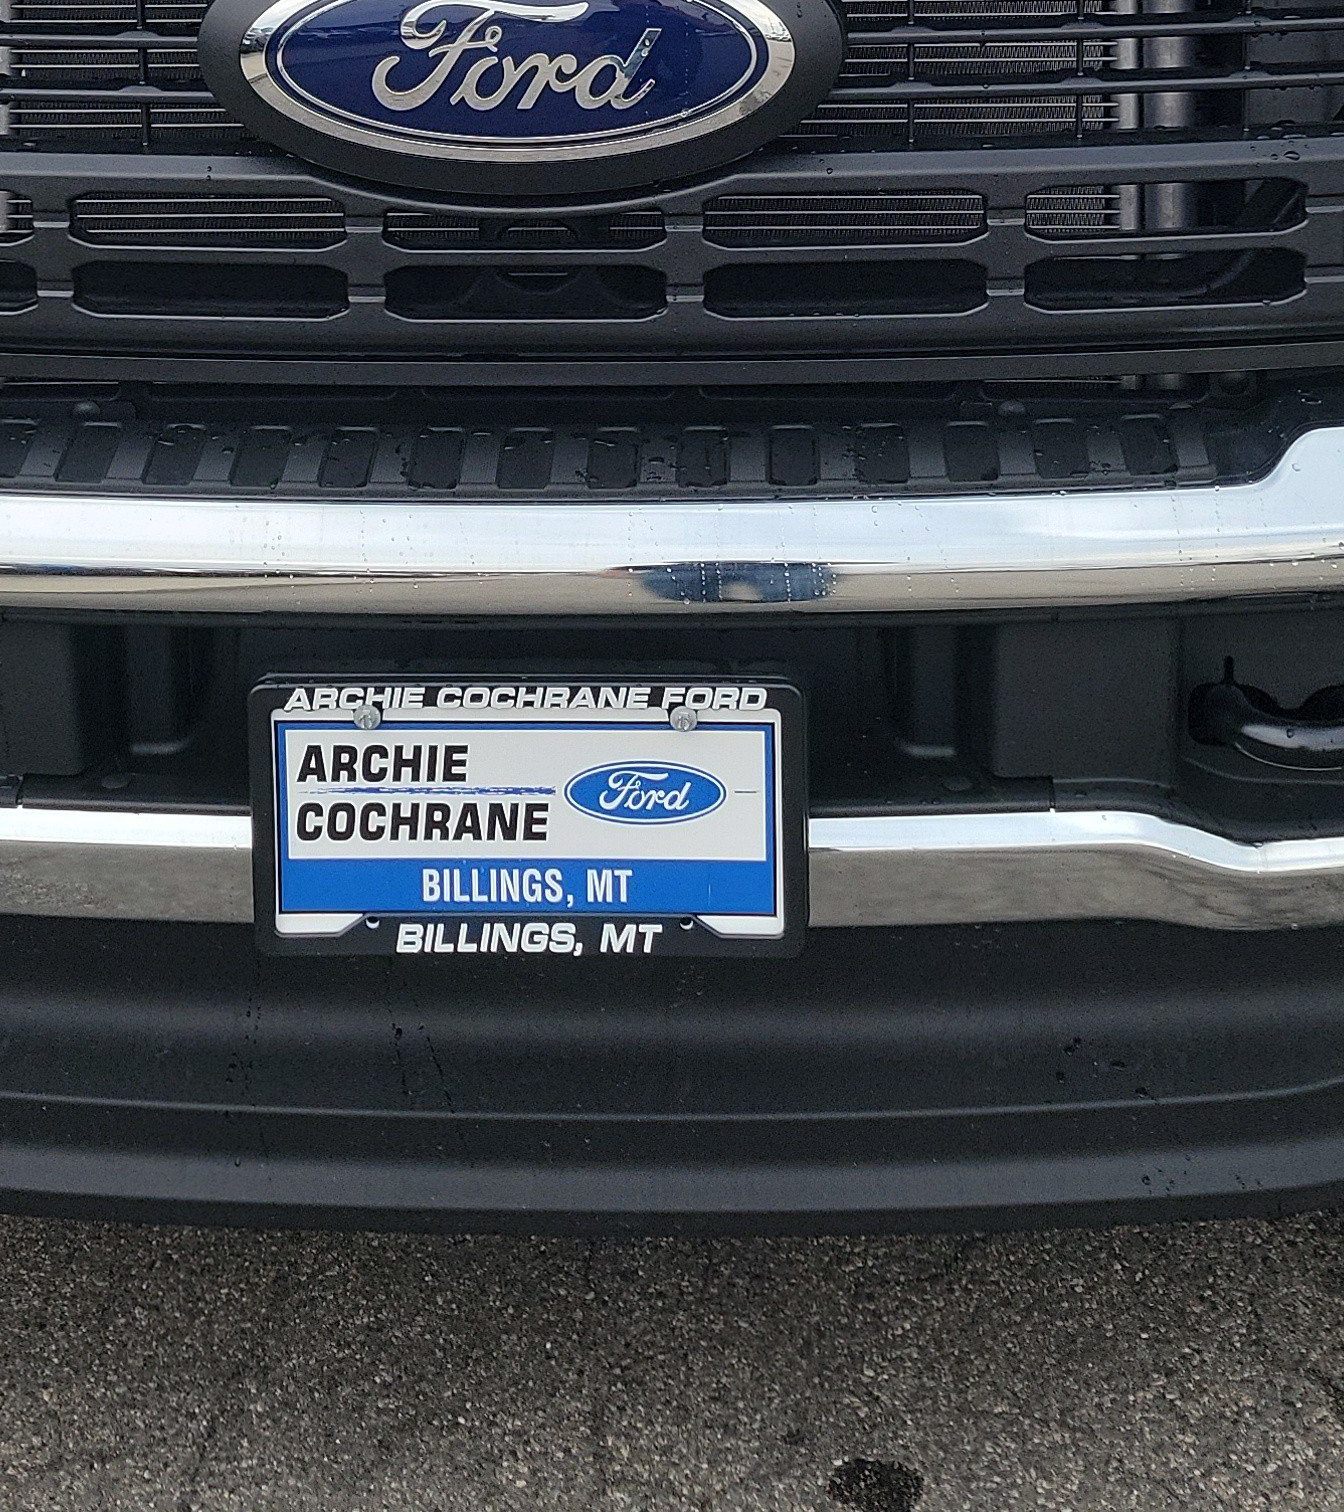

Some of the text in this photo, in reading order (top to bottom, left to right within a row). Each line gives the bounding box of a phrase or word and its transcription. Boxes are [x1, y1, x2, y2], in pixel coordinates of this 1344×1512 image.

[284, 686, 768, 711] ARCHIE COCHRANE FORD
[297, 744, 469, 783] ARCHIE
[599, 770, 690, 811] Ford
[296, 802, 550, 842] COCHRANE
[421, 868, 633, 908] BILLINGS, MT
[396, 922, 663, 956] BILLINGS, MT
